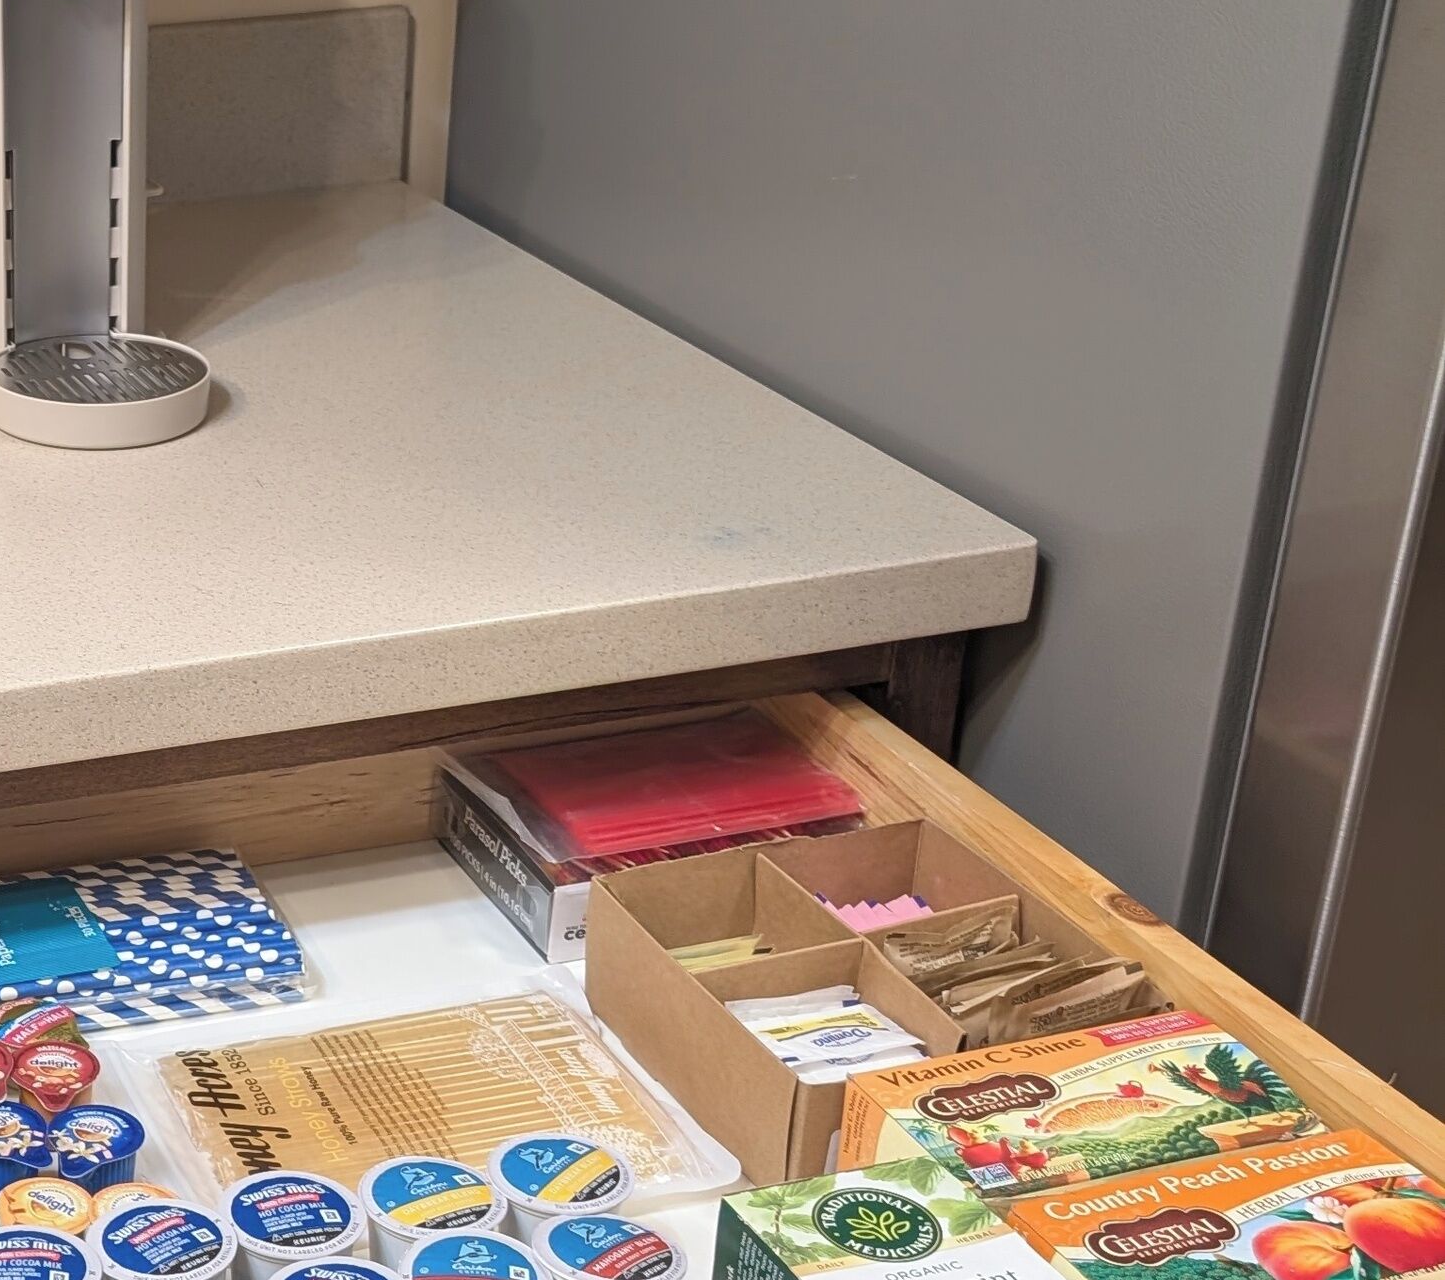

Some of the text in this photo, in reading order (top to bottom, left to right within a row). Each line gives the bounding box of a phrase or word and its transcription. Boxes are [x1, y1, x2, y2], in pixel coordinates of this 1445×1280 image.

[465, 807, 527, 887] Parasol Picks
[12, 1023, 39, 1043] HALF
[46, 1009, 69, 1023] HALF
[810, 1028, 872, 1047] Domino
[30, 1058, 79, 1069] delight
[877, 1057, 985, 1088] Vitamin
[987, 1050, 1013, 1065] C
[1020, 1036, 1087, 1058] Shine
[1058, 1035, 1221, 1082] HERBAL SUPPLEMENT Caffeine Free
[175, 1050, 246, 1118] Acres
[221, 1049, 276, 1116] Since 1852
[269, 1056, 350, 1162] Honey Straws
[301, 1066, 358, 1145] 100% Pure Raw Honey
[927, 1081, 1049, 1116] CELESTIAL
[962, 1096, 1032, 1116] SEASONINGS
[68, 1119, 119, 1137] delight
[410, 1181, 448, 1195] Caribou
[1043, 1143, 1348, 1221] Country Peach Passion
[1236, 1168, 1403, 1220] HERBAL TEA Caffeine Free
[28, 1190, 76, 1217] delight
[239, 1184, 326, 1206] SWISS MISS
[258, 1210, 276, 1218] HOT
[279, 1204, 308, 1213] COCOA
[821, 1191, 914, 1229] TRADITIONAL
[108, 1208, 187, 1245] SWISS MISS
[135, 1240, 153, 1252] HOT
[152, 1228, 180, 1244] COCOA
[179, 1224, 196, 1233] MIX
[956, 1231, 994, 1244] HERBAL
[1098, 1218, 1227, 1257] CELESTIAL
[33, 1241, 72, 1256] MISS
[293, 1235, 326, 1246] KEURIG
[592, 1233, 622, 1248] Caribou
[636, 1236, 659, 1247] BLEND
[845, 1225, 934, 1258] MEDICINALS
[1137, 1236, 1210, 1258] SEASONINGS
[10, 1259, 41, 1267] COCOA
[43, 1261, 62, 1269] MIX
[180, 1255, 210, 1271] KEURIG
[452, 1264, 497, 1272] Caribou
[817, 1260, 845, 1270] DAILY
